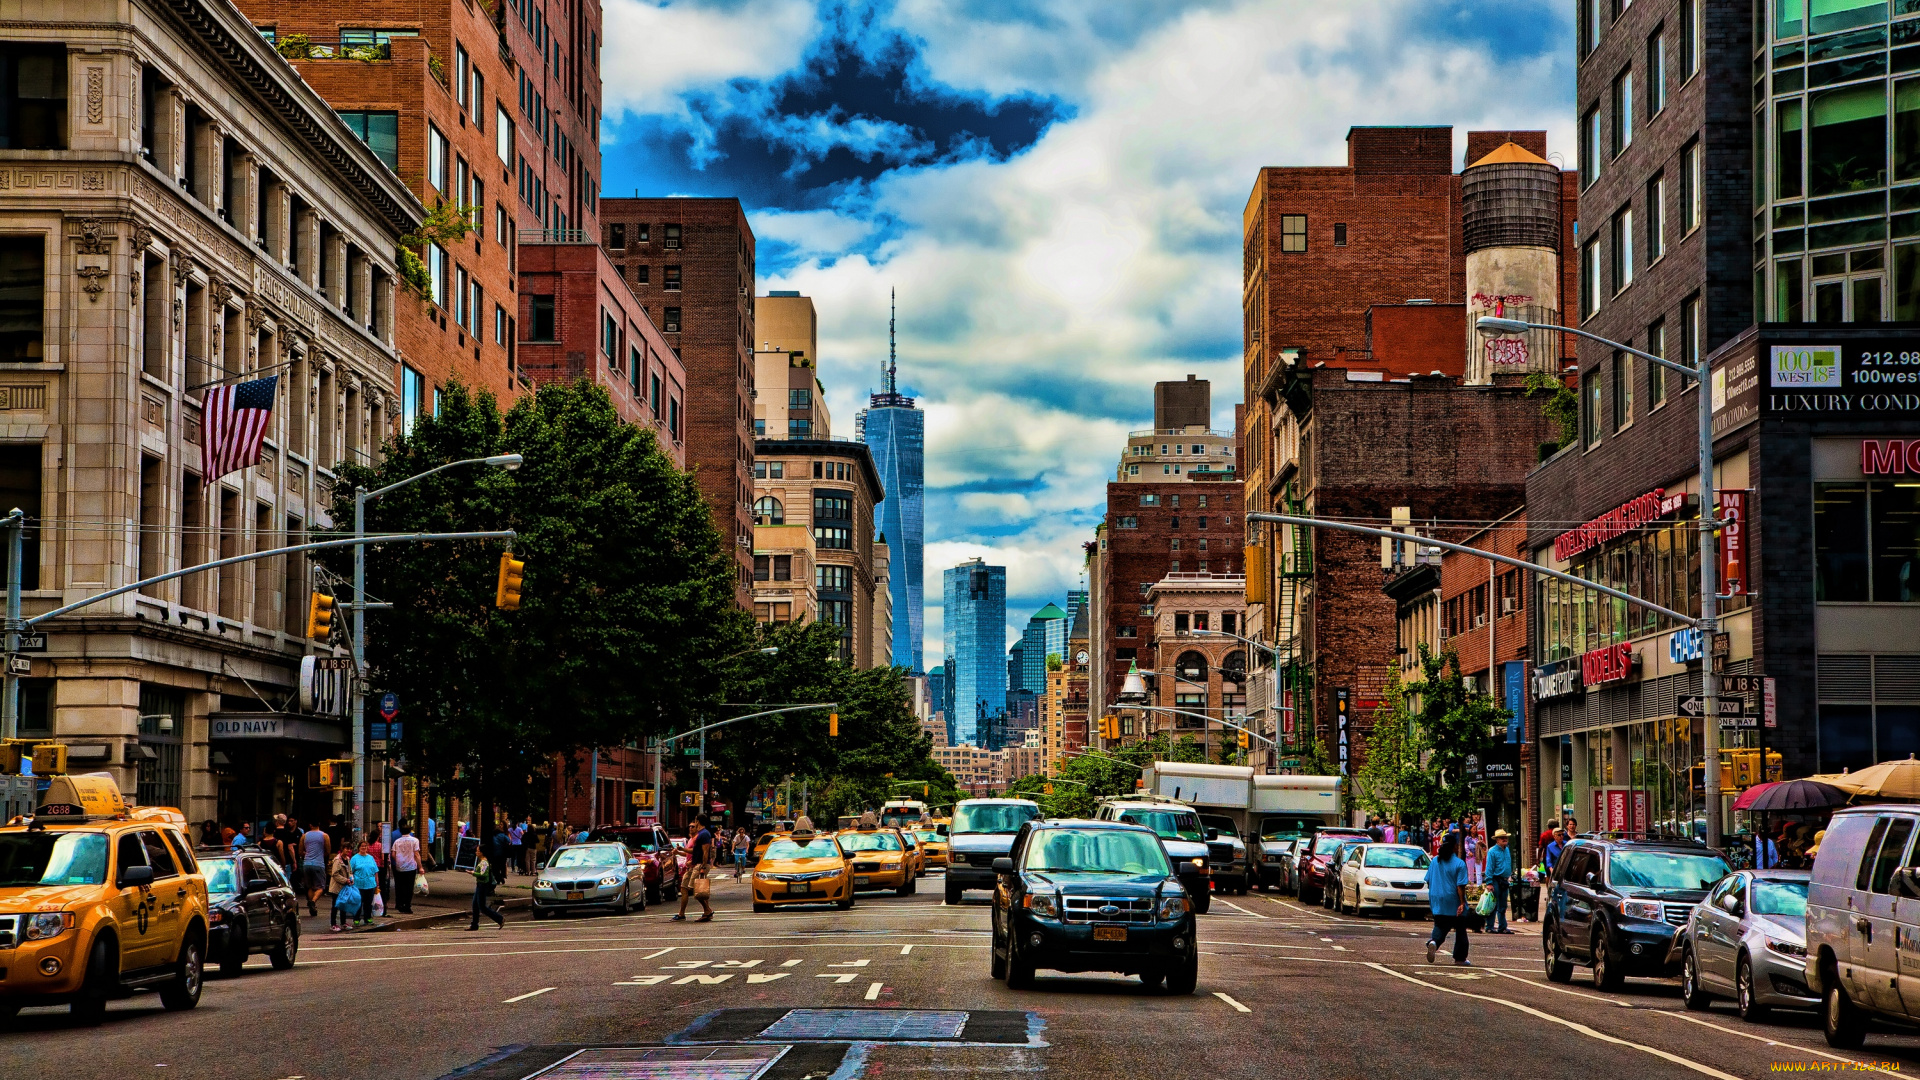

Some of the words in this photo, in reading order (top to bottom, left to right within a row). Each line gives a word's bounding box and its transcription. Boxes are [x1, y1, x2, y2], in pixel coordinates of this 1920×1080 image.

[260, 269, 281, 302] PRICE
[284, 287, 316, 327] BUILDING
[1776, 351, 1811, 371] 100
[1777, 372, 1812, 382] WEST
[1813, 367, 1829, 383] 18
[1770, 394, 1855, 411] LUXURY
[1587, 503, 1630, 550] SPORTING
[1628, 488, 1665, 529] GOODS
[1669, 627, 1704, 663] CHASE
[320, 659, 328, 669] W
[330, 659, 338, 669] 18
[340, 659, 350, 669] ST
[1723, 677, 1733, 690] W
[1737, 677, 1748, 690] 18
[1687, 701, 1704, 711] ONE
[216, 721, 240, 732] OLD
[243, 721, 277, 732] NAVY
[1338, 714, 1348, 775] PARK
[47, 805, 70, 814] 2G88
